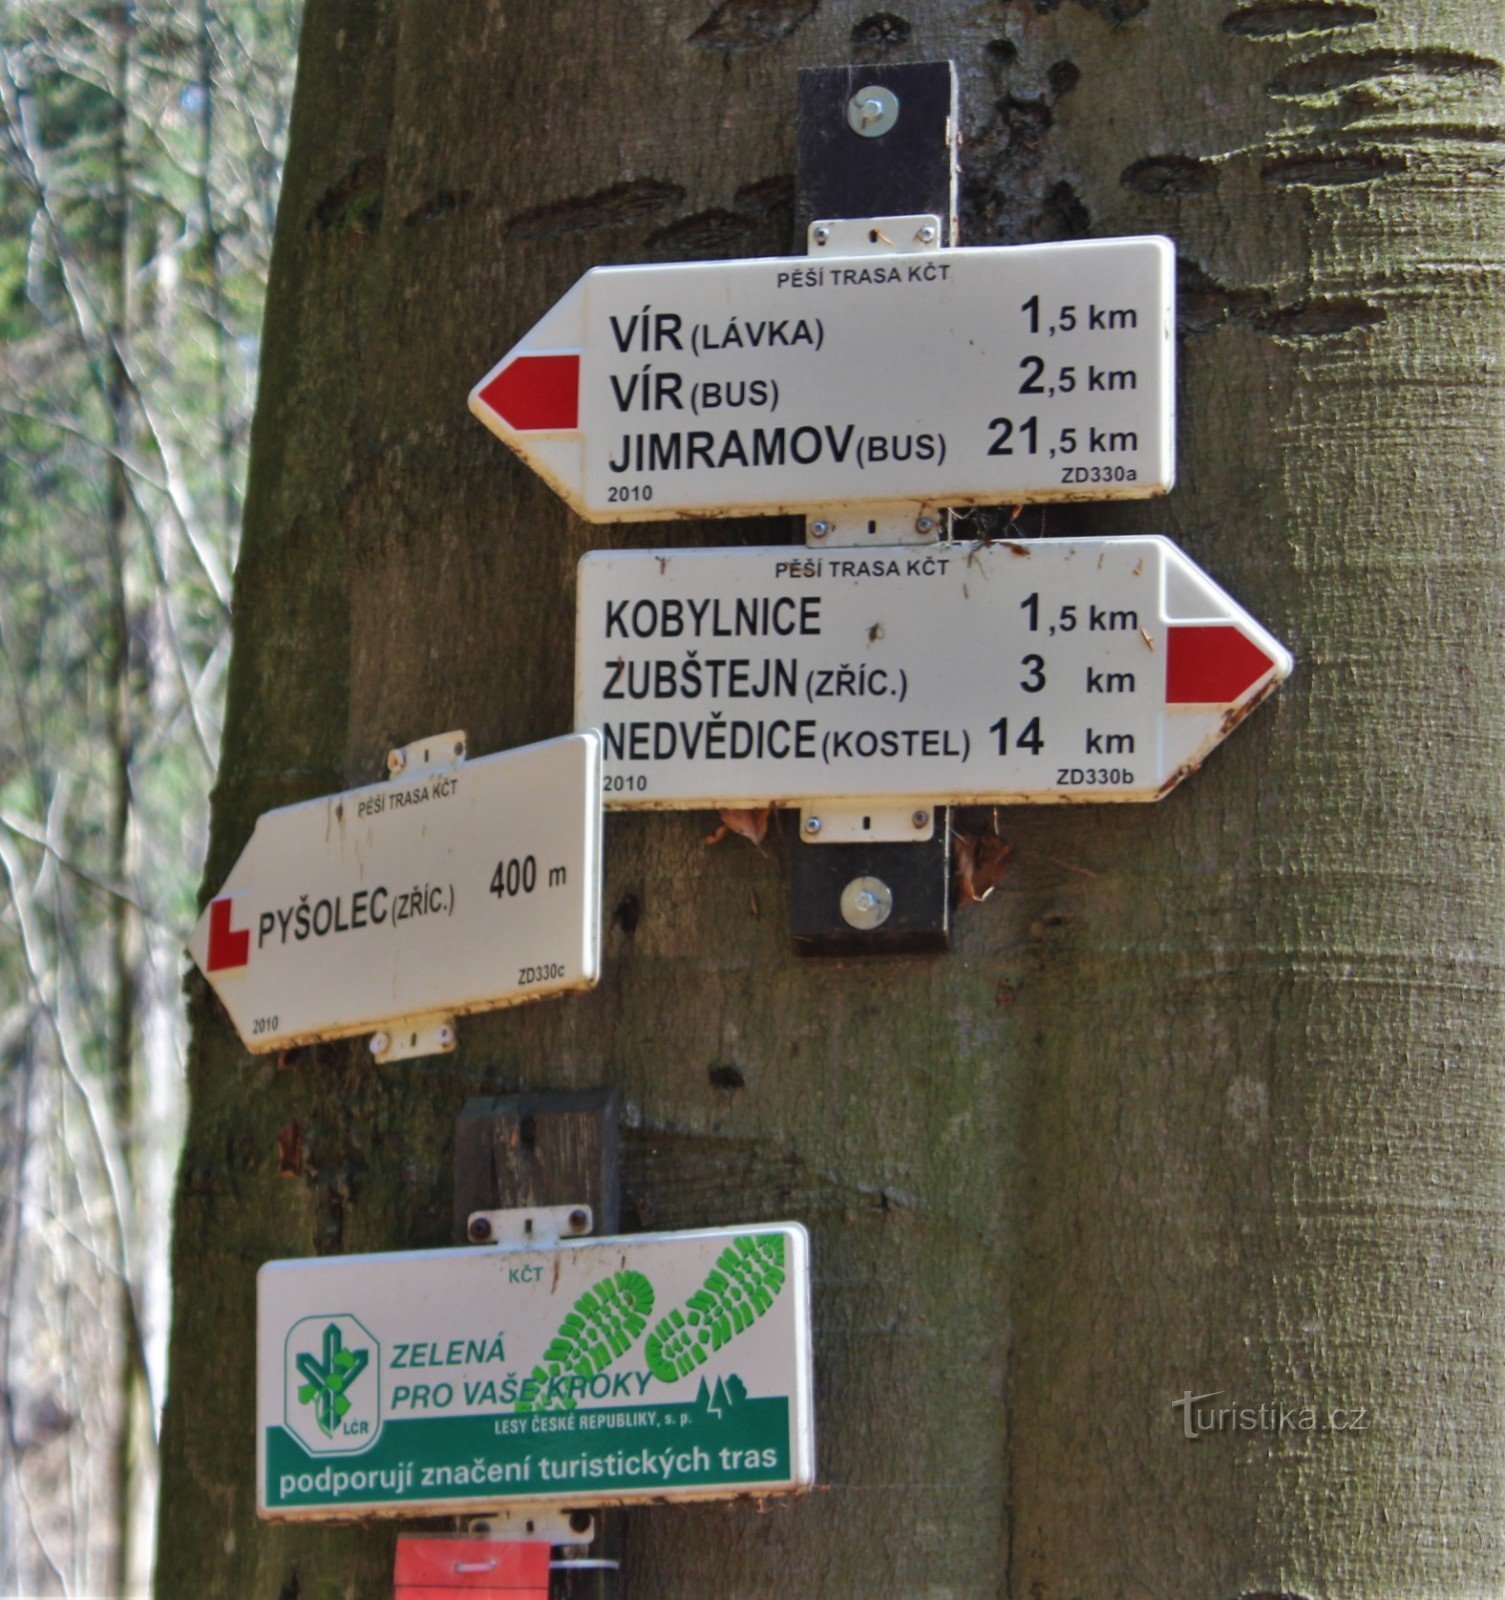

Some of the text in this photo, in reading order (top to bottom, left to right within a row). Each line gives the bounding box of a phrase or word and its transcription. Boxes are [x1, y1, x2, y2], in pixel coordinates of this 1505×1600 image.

[777, 262, 951, 288] PĚŠÍ TRASA KČT
[609, 304, 684, 353] VÍR
[1021, 294, 1137, 337] 1,5 km
[610, 363, 684, 412] VÍR
[1018, 355, 1137, 398] 2,5 km
[987, 415, 1138, 458] 21,5 km
[607, 484, 653, 503] 2010
[1061, 465, 1137, 484] ZD330a
[775, 555, 950, 579] PĚŠÍ TRASA KČT
[605, 596, 822, 638] KOBYLNICE
[1020, 592, 1138, 637] 1,5 km
[602, 650, 798, 700] ZUBŠTEJN
[1020, 653, 1135, 693] 3 km
[989, 716, 1135, 756] 14 km
[602, 774, 648, 792] 2010
[1056, 768, 1134, 786] ZD330b
[357, 778, 458, 818] PĚŠÍ TRASA KČT
[489, 854, 567, 899] 400 m
[518, 963, 565, 985] ZD330c
[252, 1015, 279, 1035] 2010
[507, 1264, 545, 1284] KČT
[388, 1330, 507, 1370] ZELENÁ
[389, 1369, 654, 1412] PRO VAŠE KROKY
[494, 1418, 528, 1435] LESY
[530, 1409, 575, 1433] ČESKÉ
[579, 1411, 661, 1431] REPUBLIKY,
[279, 1447, 778, 1498] podporují značení turistických tras
